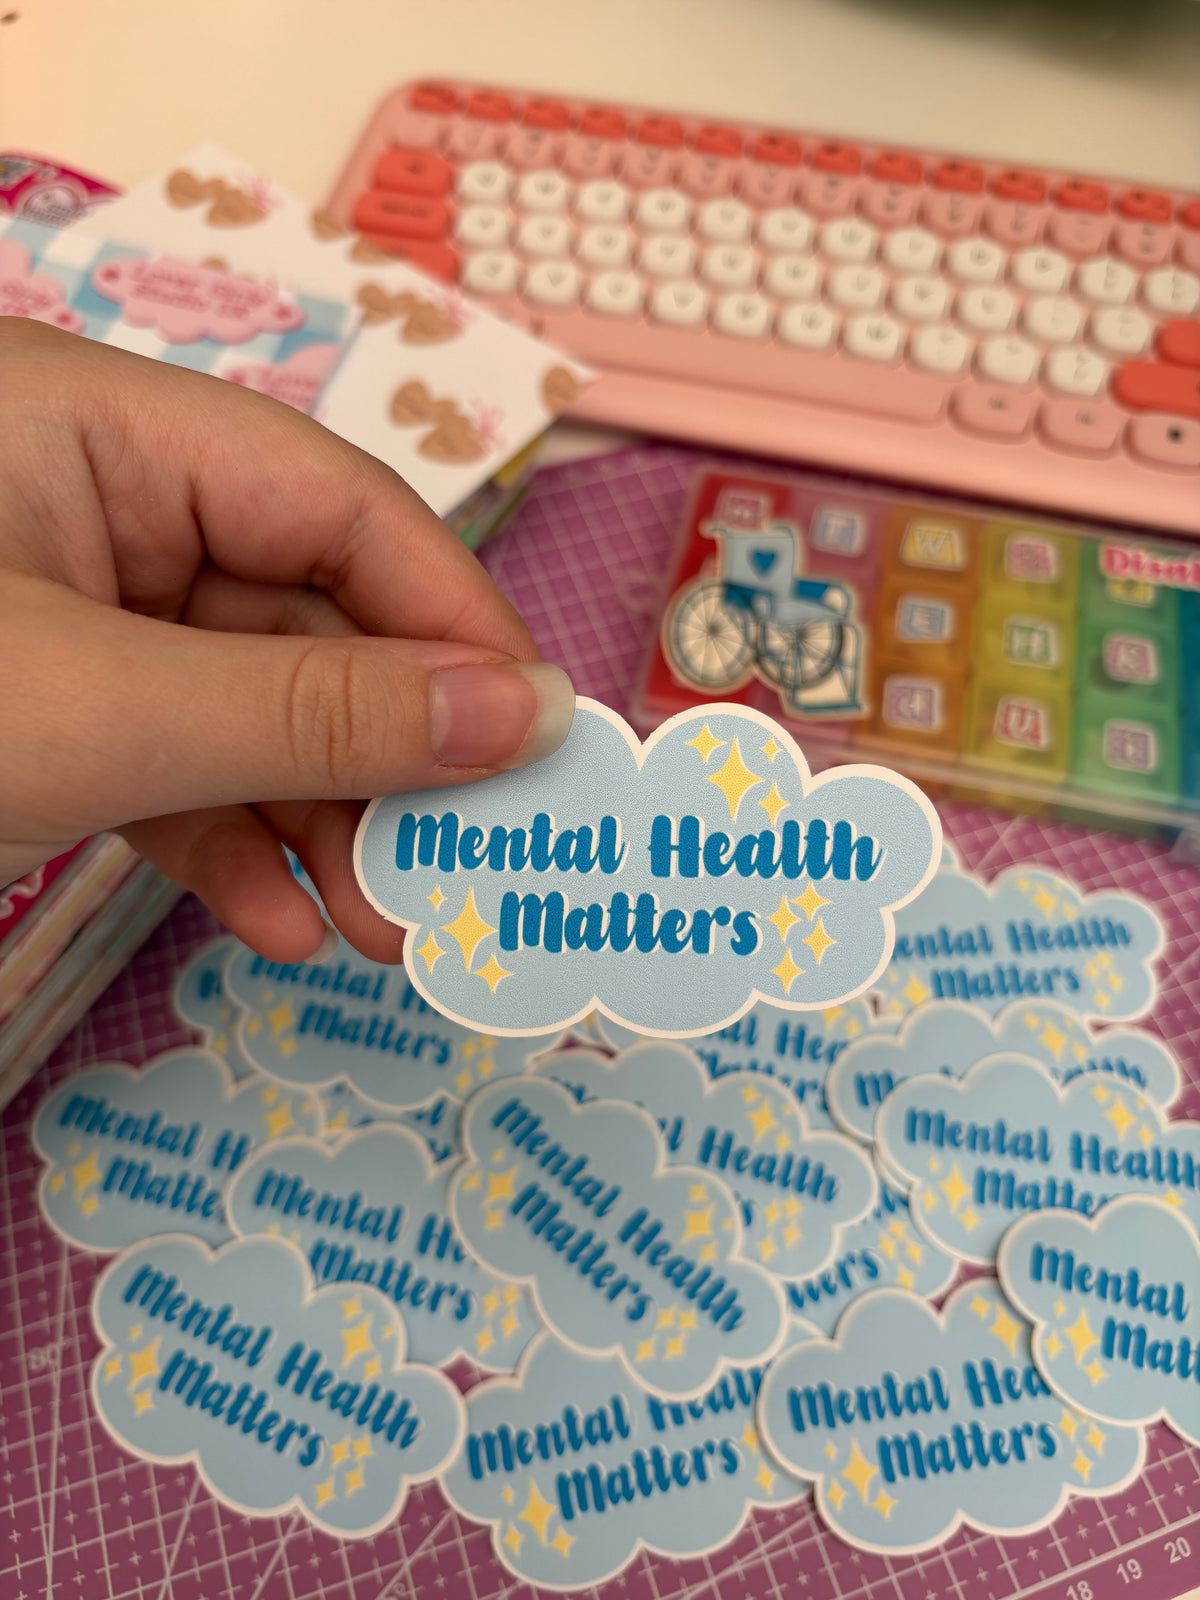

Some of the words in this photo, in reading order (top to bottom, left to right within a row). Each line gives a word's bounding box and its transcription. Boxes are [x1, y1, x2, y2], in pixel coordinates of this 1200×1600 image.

[395, 811, 625, 874] Mental
[648, 814, 883, 881] Health
[499, 891, 761, 956] Matters
[891, 921, 994, 963] ental
[1004, 915, 1133, 955] Health
[930, 961, 1081, 1000] Matters
[299, 1002, 450, 1065] Matters
[58, 1094, 204, 1159] Mental
[697, 1124, 838, 1203] Health
[903, 1105, 1051, 1164] Mental
[102, 1154, 226, 1221] Matte
[253, 1168, 405, 1244] Mental
[491, 1097, 622, 1218] Mental
[617, 1207, 746, 1333] Health
[309, 1237, 474, 1321] Matters
[509, 1180, 653, 1322] Matters
[1029, 1241, 1190, 1323] Mental
[122, 1263, 273, 1367] Mental
[274, 1341, 421, 1450] Health
[157, 1348, 326, 1467] Matters
[787, 1365, 950, 1433] Mental
[962, 1357, 1052, 1409] Hea
[467, 1393, 631, 1481] Mental
[876, 1420, 1058, 1484] Matters
[556, 1437, 739, 1521] Matters
[1066, 1580, 1093, 1600] 18
[1116, 1558, 1143, 1584] 19
[1164, 1537, 1191, 1564] 20
